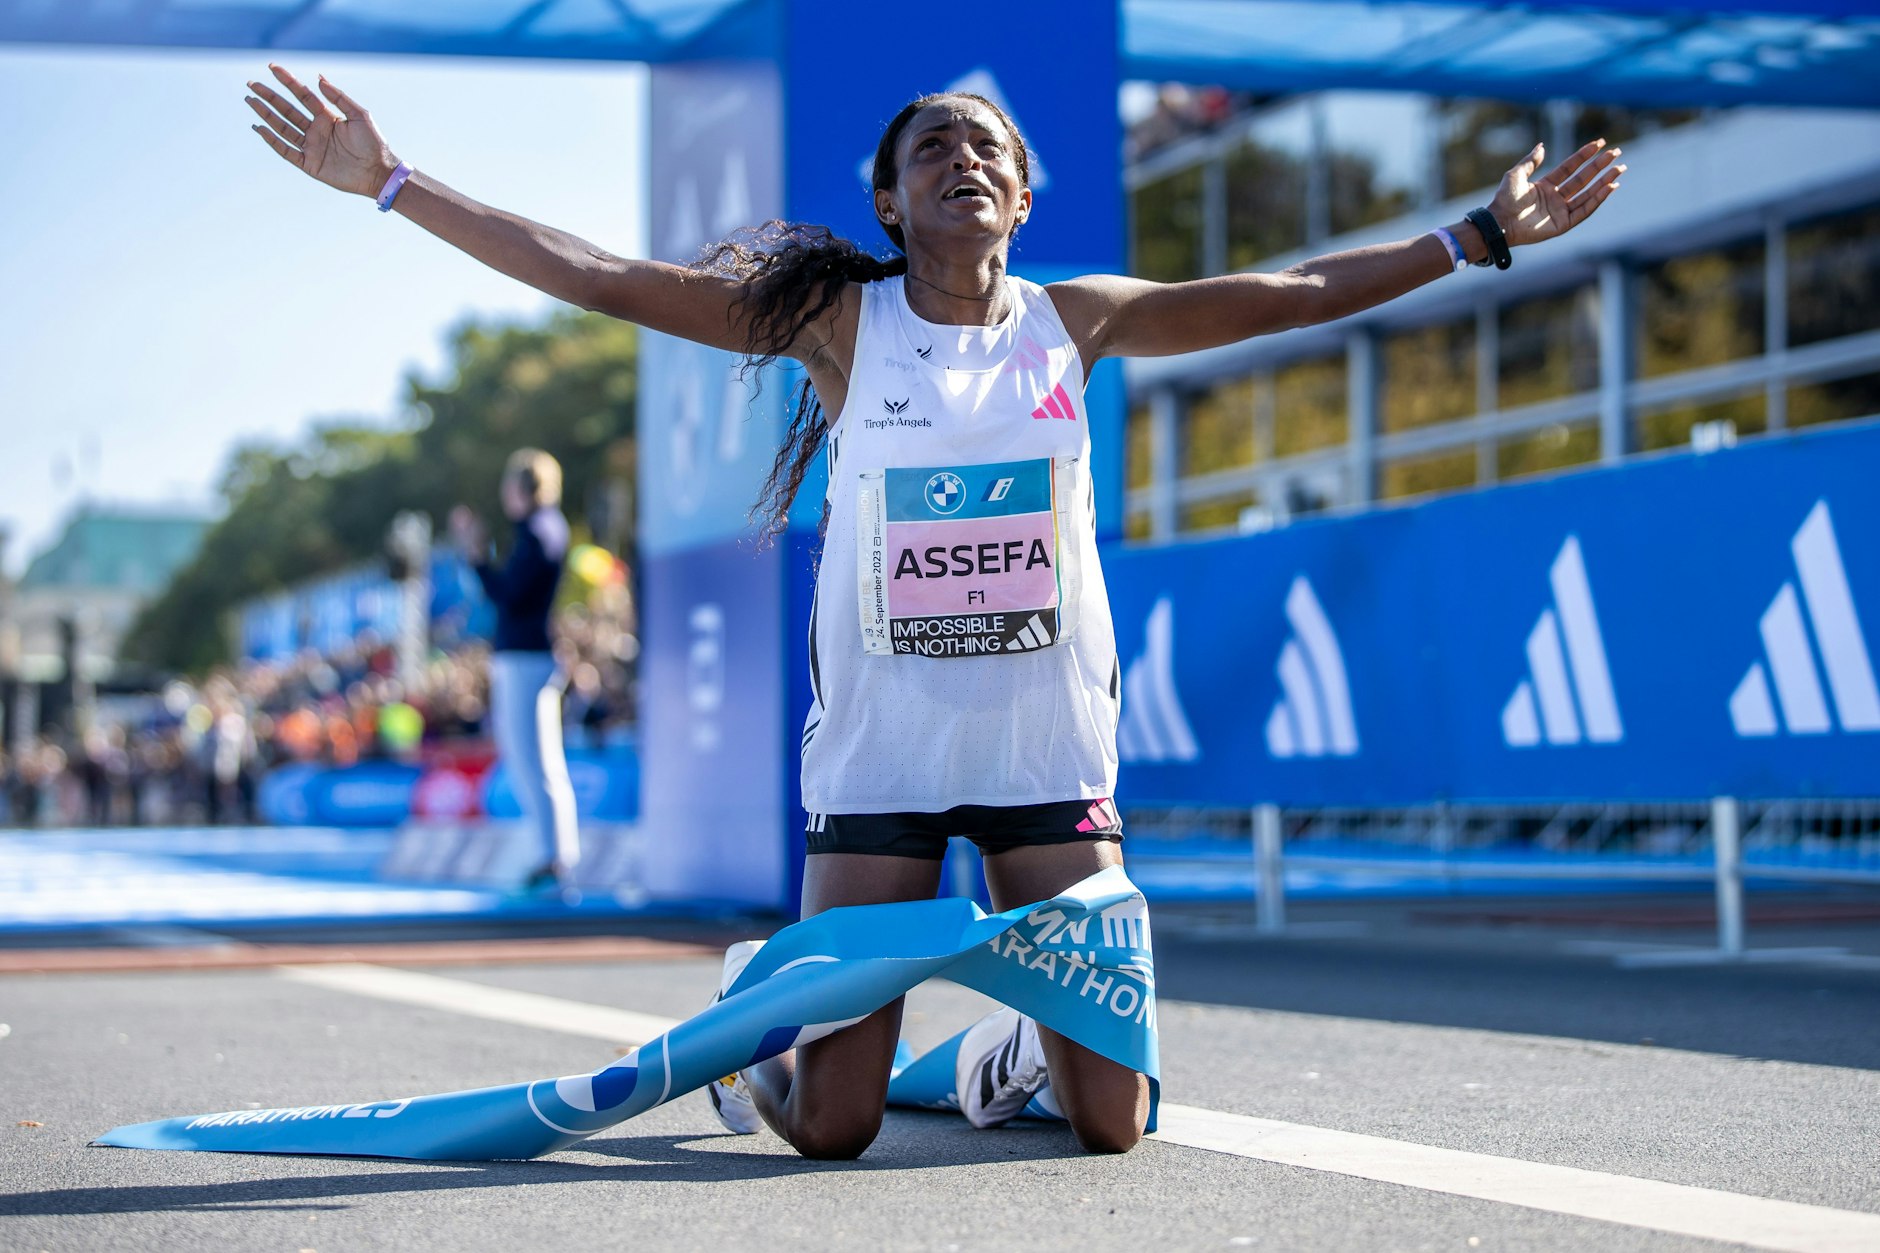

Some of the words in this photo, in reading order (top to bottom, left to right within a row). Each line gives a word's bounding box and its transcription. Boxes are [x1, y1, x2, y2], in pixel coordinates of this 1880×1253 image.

[864, 417, 894, 429] Tirop's
[896, 417, 932, 428] Angels
[873, 550, 881, 573] 2023
[894, 538, 1051, 579] ASSEFA
[874, 576, 885, 624] September
[968, 590, 985, 604] F1
[863, 598, 872, 623] BMW
[893, 616, 1005, 638] IMPOSSIBLE
[895, 640, 911, 652] IS
[915, 636, 1001, 655] NOTHING
[988, 927, 1153, 1028] RATHON
[185, 1105, 350, 1130] MARATHON
